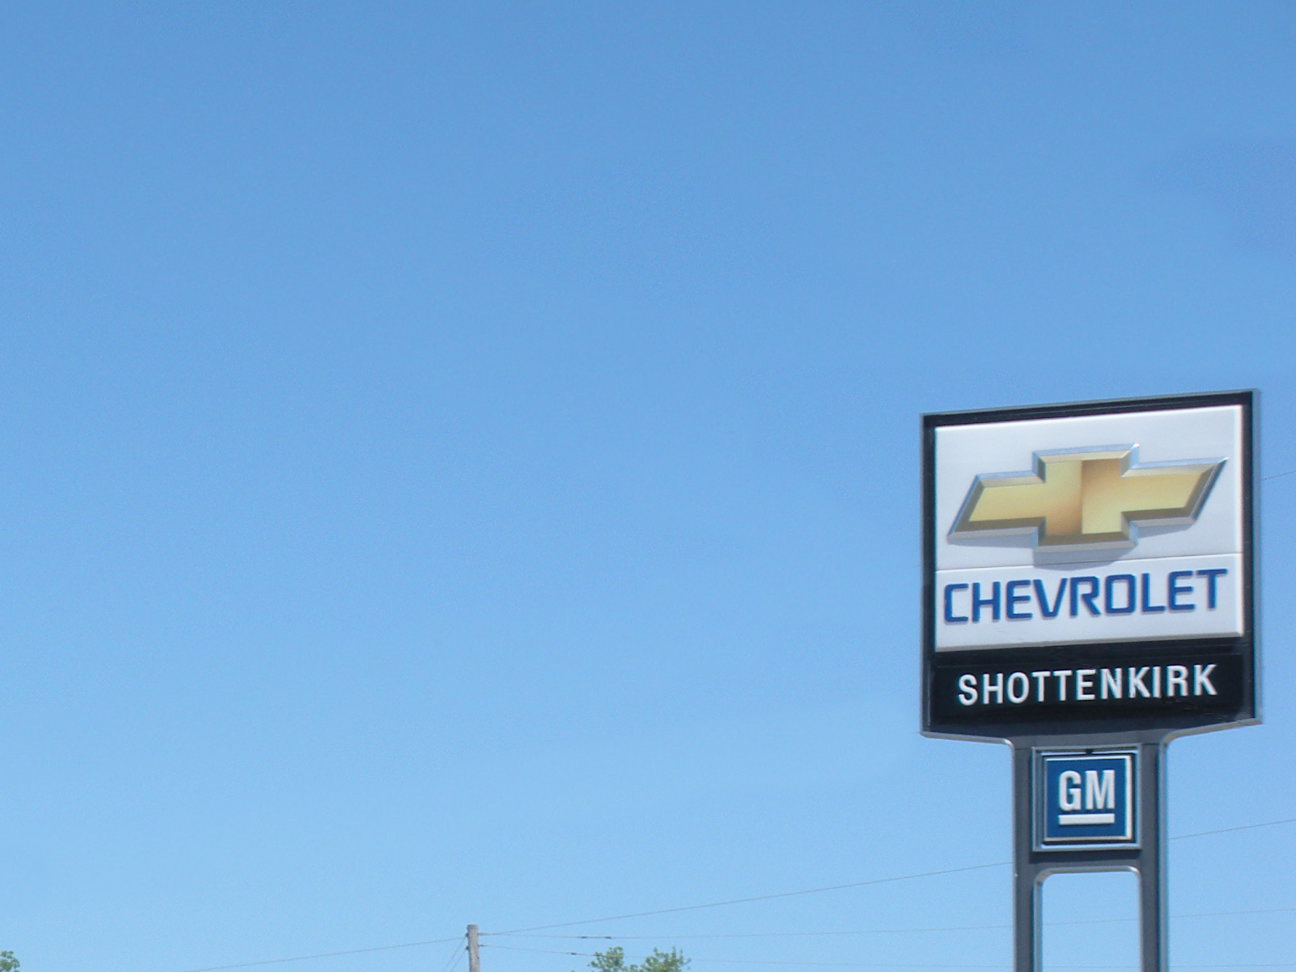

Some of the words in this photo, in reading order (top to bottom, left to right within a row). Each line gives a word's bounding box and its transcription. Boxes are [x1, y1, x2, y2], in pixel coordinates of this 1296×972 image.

[944, 568, 1227, 624] CHEVROLET
[957, 663, 1219, 707] SHOTTENKIRK
[1057, 768, 1116, 812] GM
